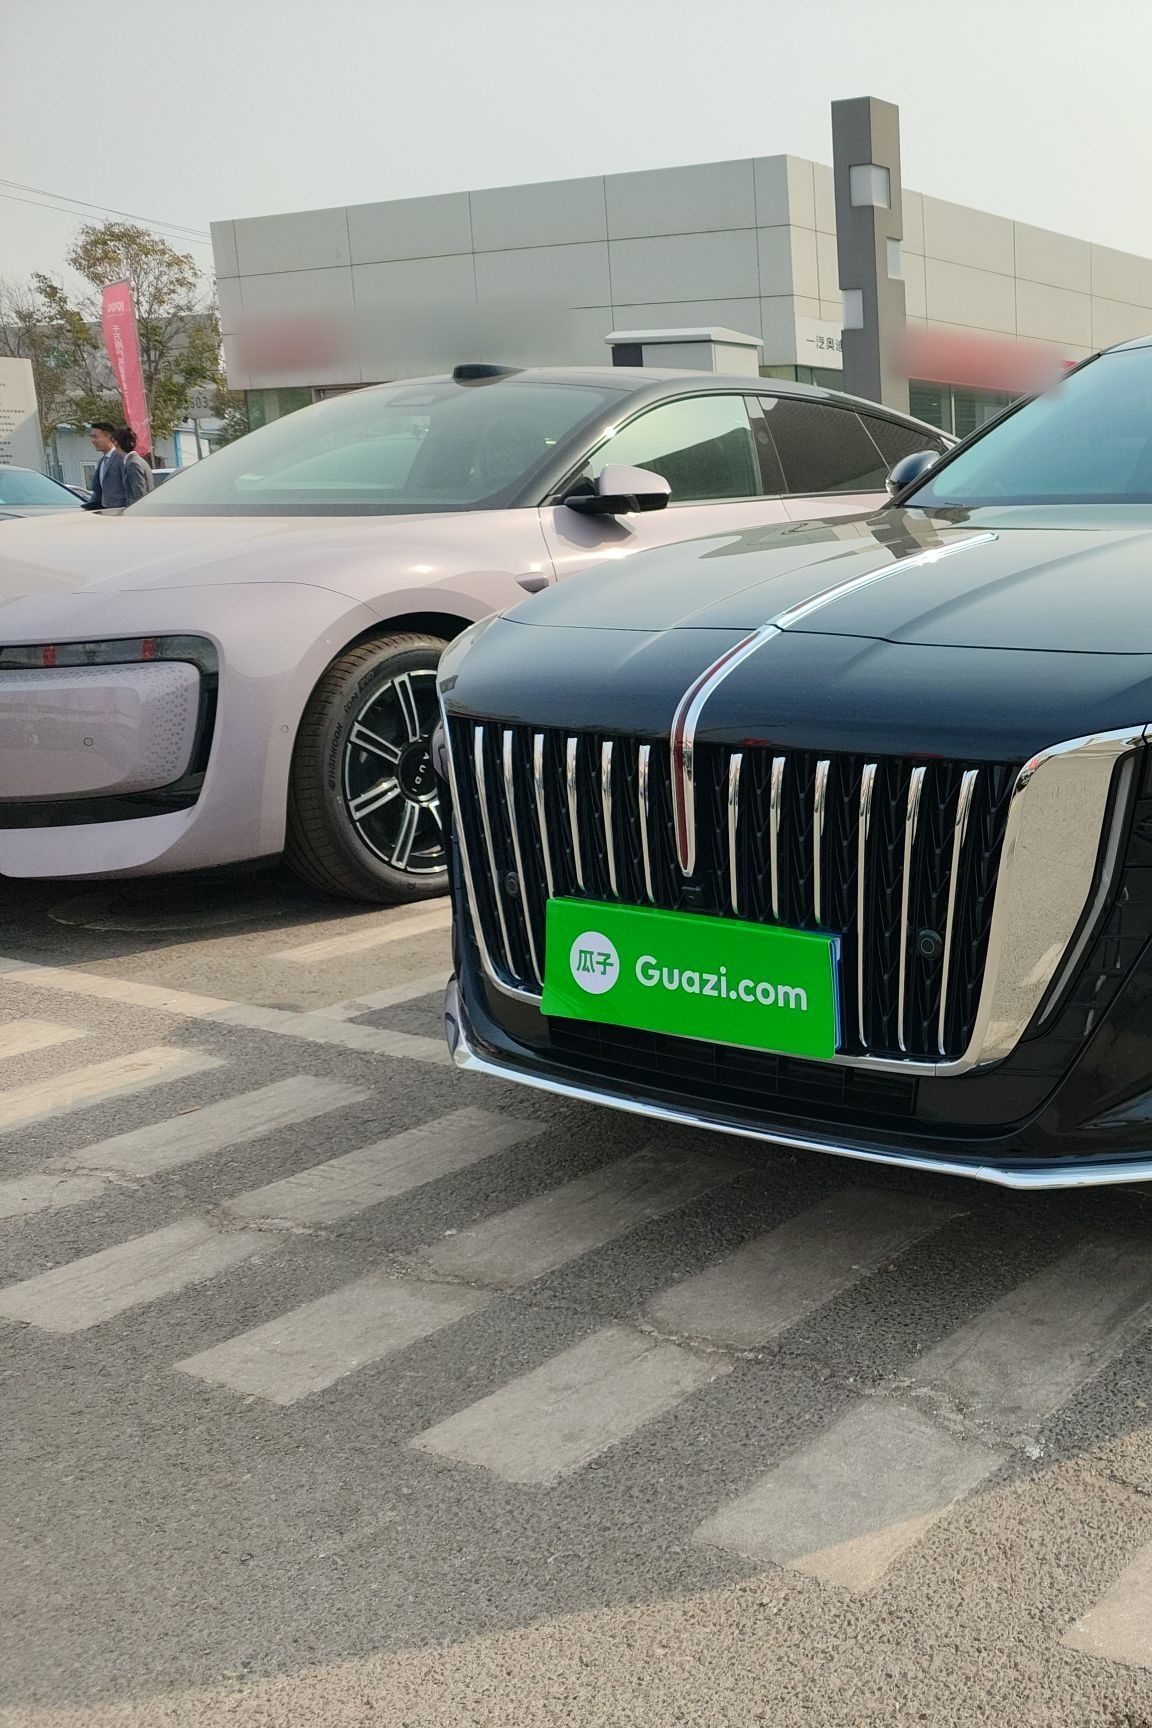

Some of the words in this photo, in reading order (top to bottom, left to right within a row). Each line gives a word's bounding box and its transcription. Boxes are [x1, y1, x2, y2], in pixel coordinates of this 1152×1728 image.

[411, 751, 431, 793] AUDI
[576, 949, 614, 976] 瓜子
[635, 955, 807, 1011] Guazi.com
